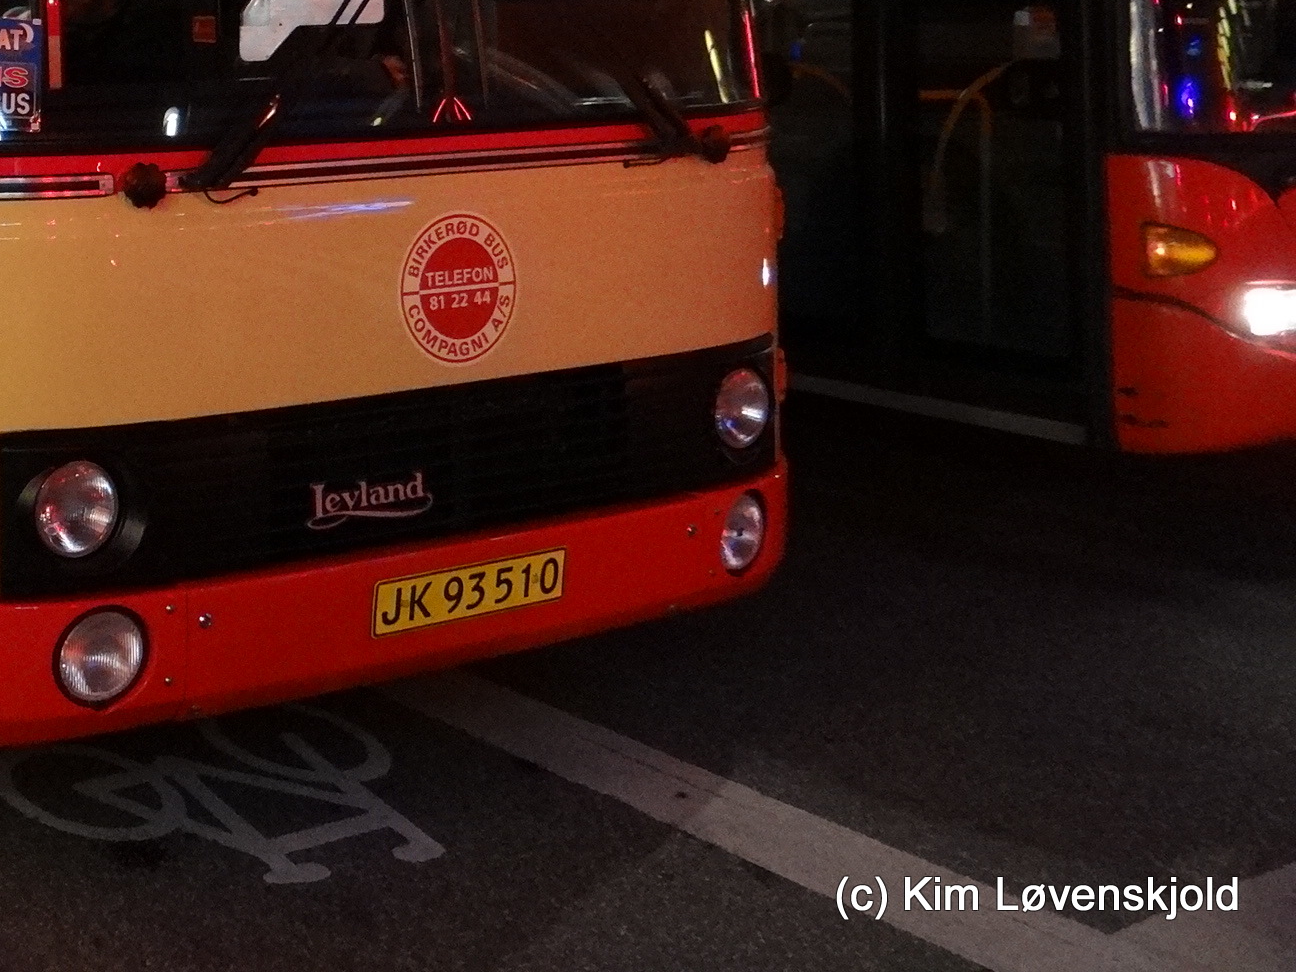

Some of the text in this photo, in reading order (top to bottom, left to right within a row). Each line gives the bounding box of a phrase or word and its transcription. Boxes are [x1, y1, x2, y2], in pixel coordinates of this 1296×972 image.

[408, 220, 509, 278] BIRKERØD BUS
[425, 266, 494, 288] TELEFON
[429, 289, 491, 311] 81 22 44
[408, 294, 510, 357] COMPAGNI A/S
[308, 472, 432, 527] Leyland
[381, 581, 433, 626] JK
